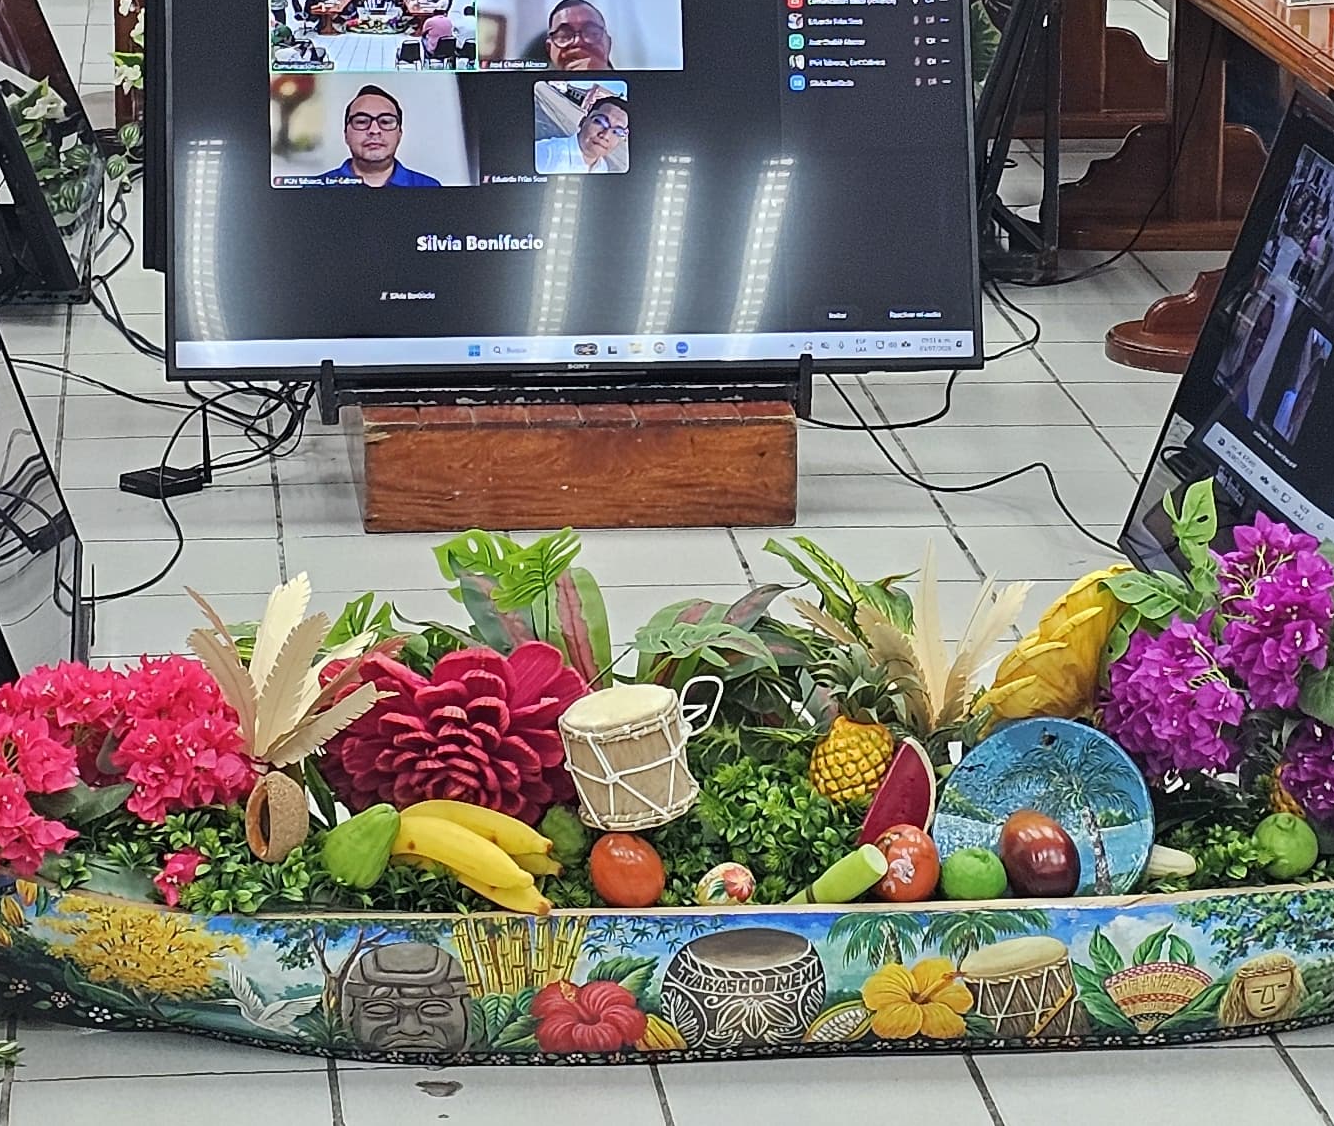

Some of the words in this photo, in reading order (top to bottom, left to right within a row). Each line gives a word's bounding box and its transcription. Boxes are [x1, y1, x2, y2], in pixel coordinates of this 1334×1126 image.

[416, 234, 462, 252] Silvia
[466, 233, 544, 251] Bonifacio
[677, 962, 765, 995] TABASCO
